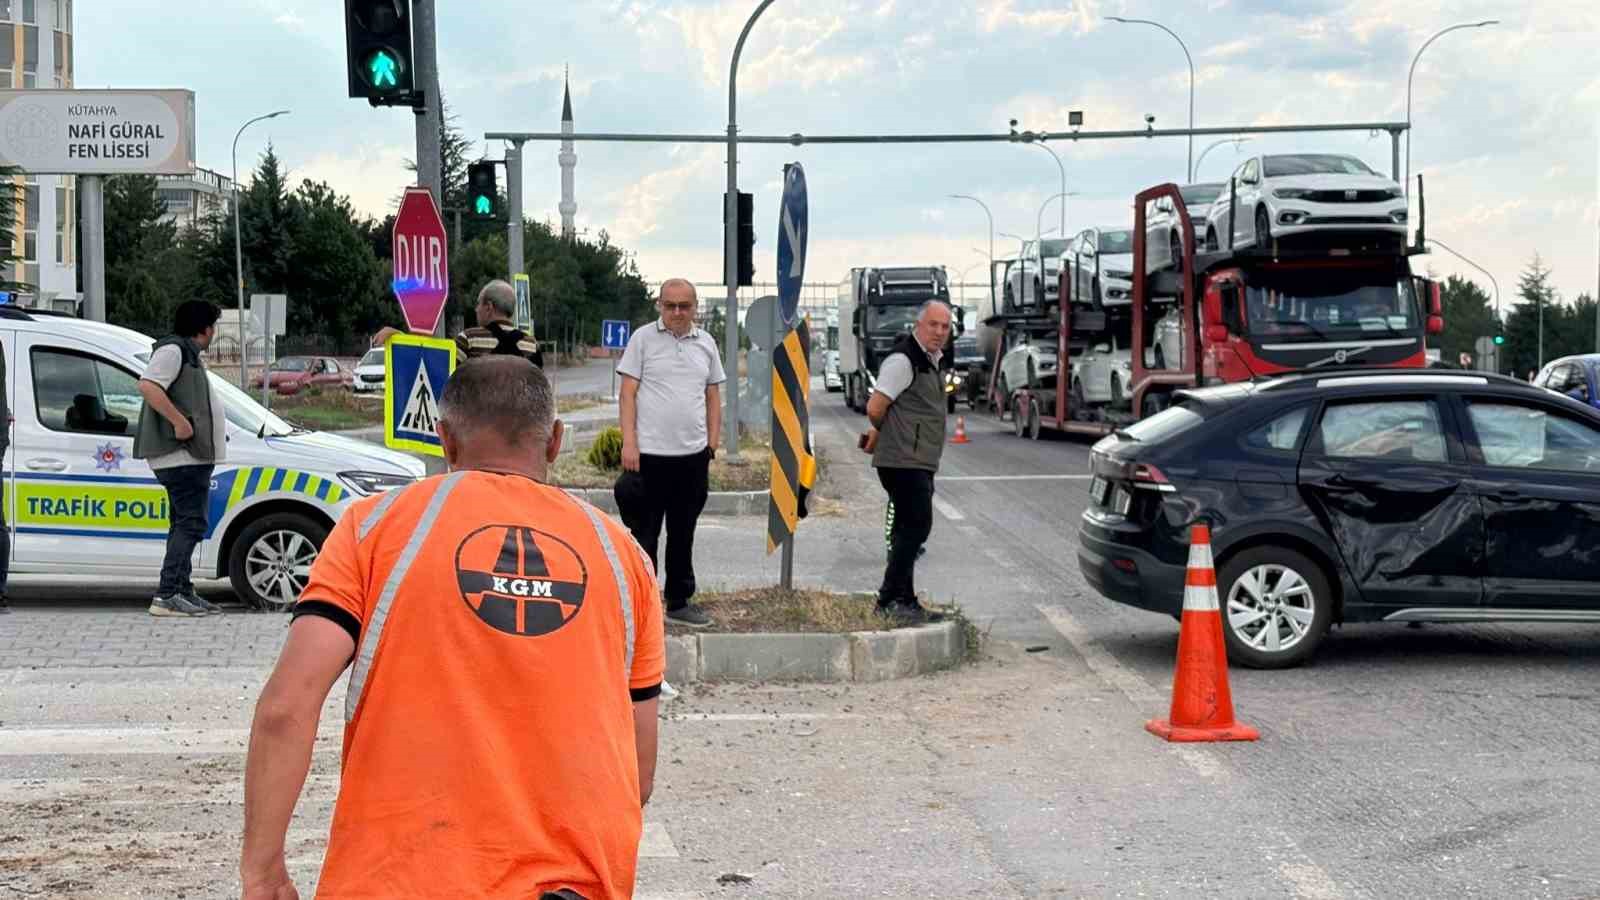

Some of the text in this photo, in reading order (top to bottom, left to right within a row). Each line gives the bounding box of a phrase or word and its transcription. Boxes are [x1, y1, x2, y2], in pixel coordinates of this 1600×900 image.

[68, 103, 117, 116] KÜTAHYA
[68, 121, 164, 139] NAFİ GÜRAL
[68, 140, 149, 159] FEN LİSESİ
[397, 233, 443, 290] DUR
[27, 494, 169, 520] TRAFİK POLİ
[492, 576, 553, 597] KGM
